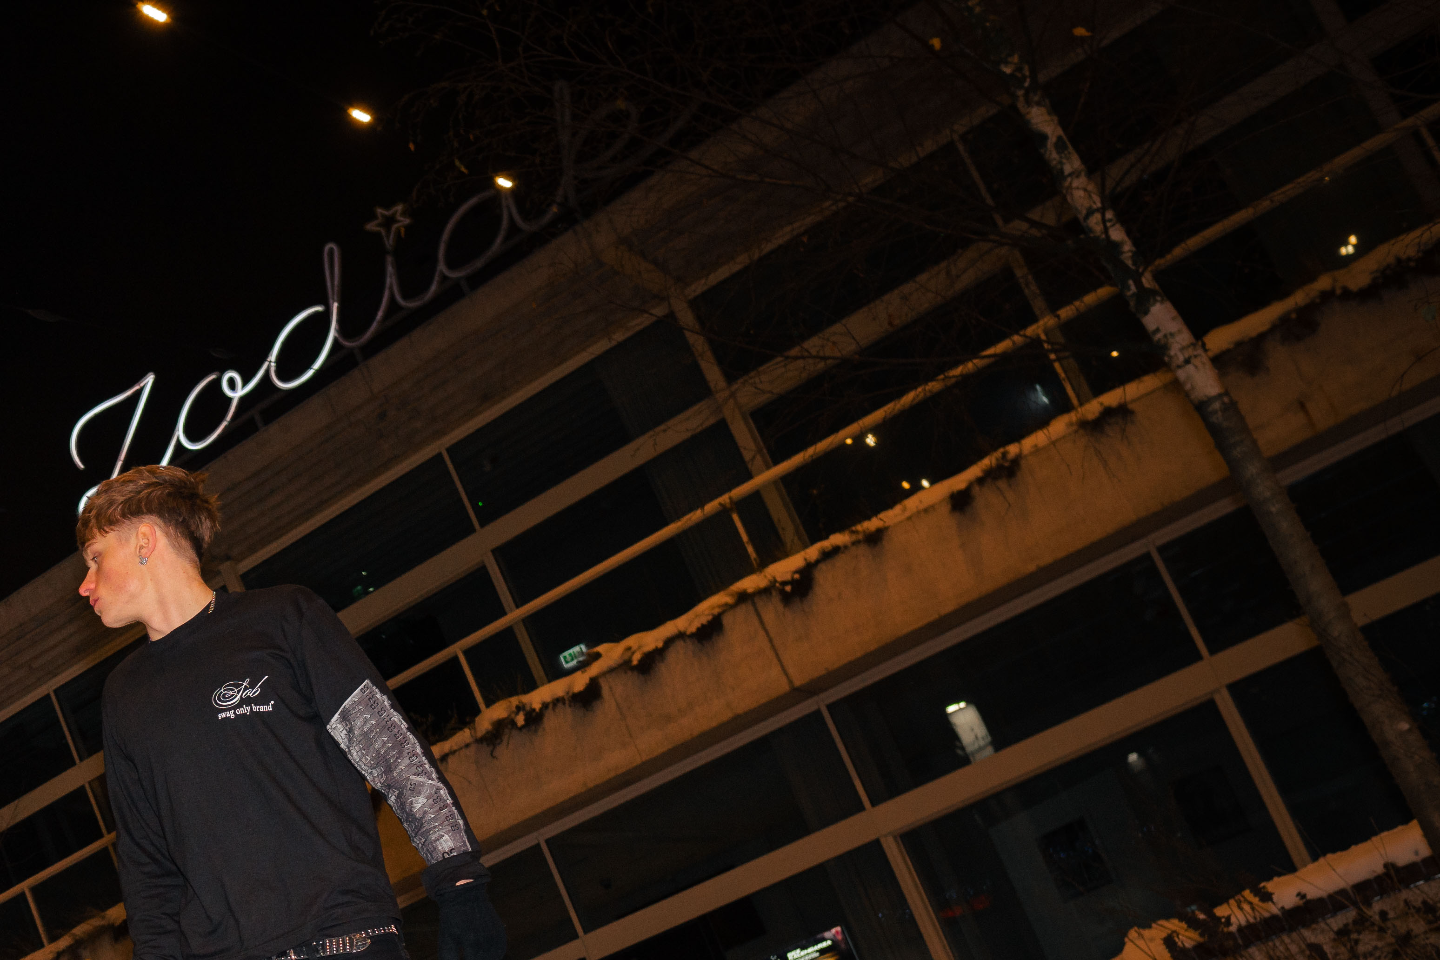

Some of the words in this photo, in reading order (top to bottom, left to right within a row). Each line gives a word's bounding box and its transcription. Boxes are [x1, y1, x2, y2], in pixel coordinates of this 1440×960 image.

[217, 709, 235, 720] swag
[236, 704, 251, 716] only
[251, 702, 273, 712] brand
